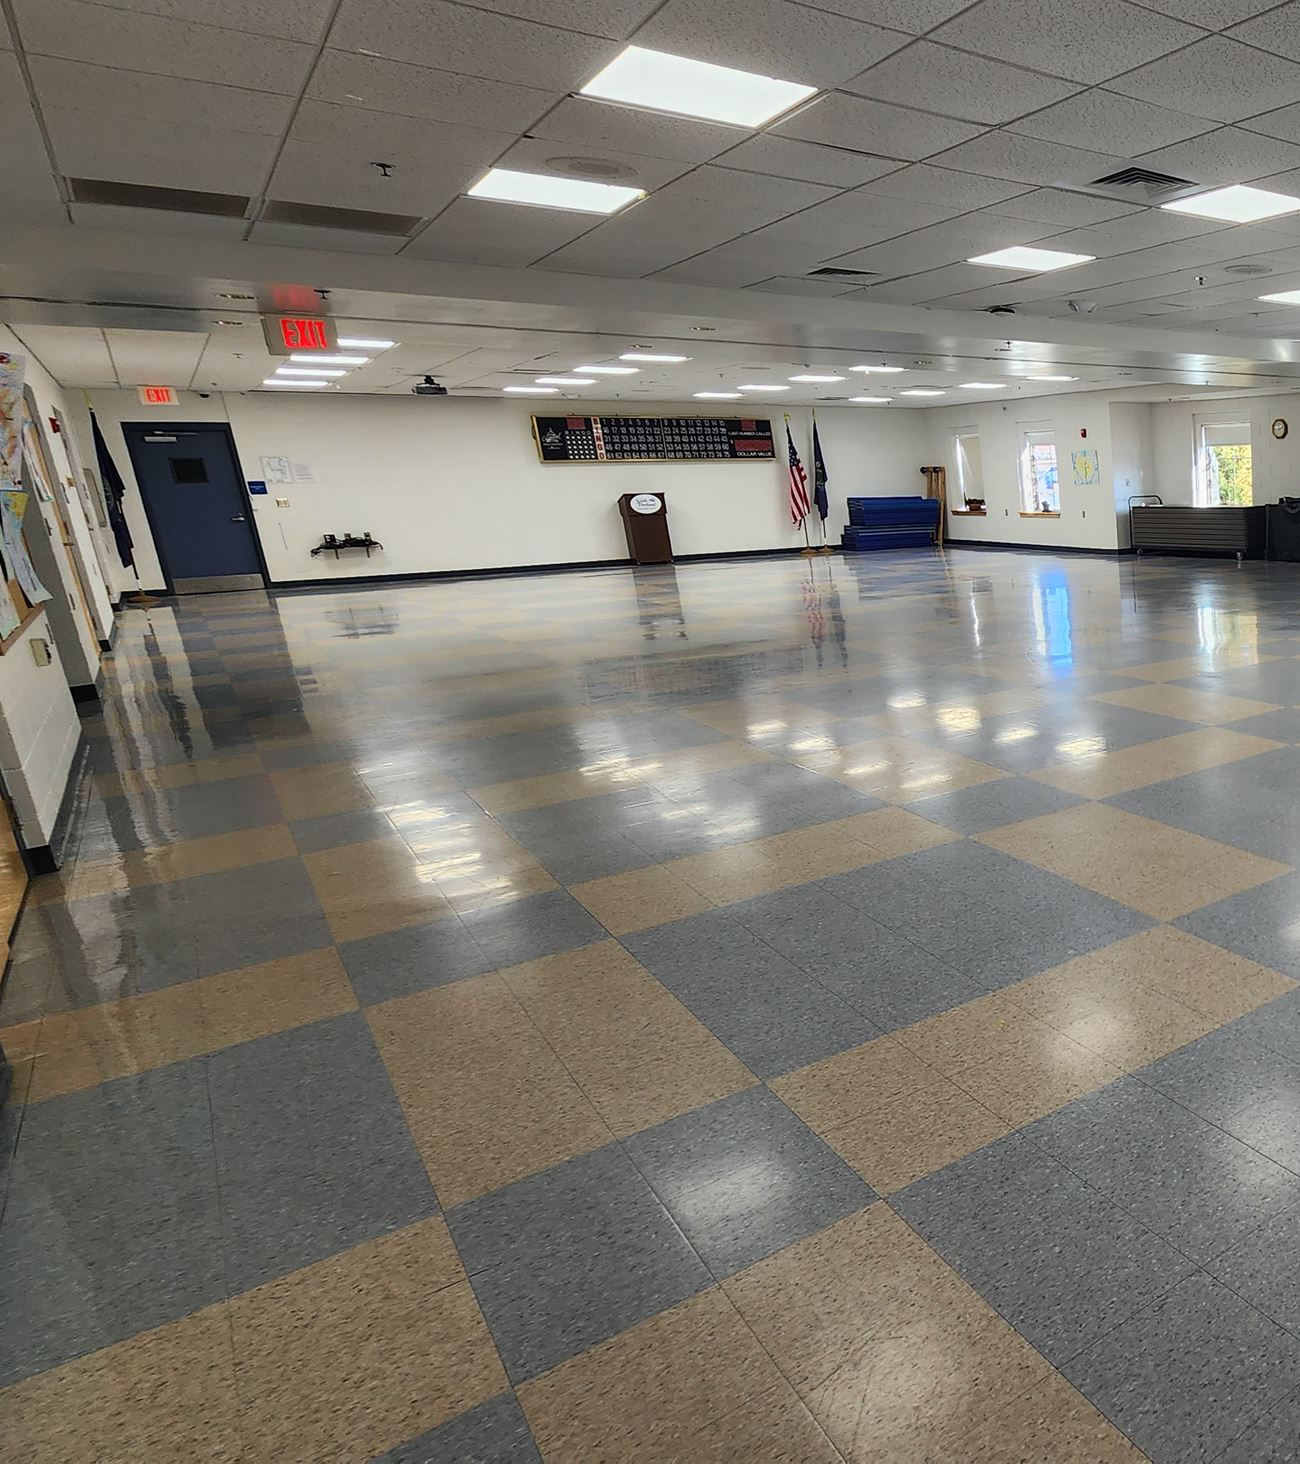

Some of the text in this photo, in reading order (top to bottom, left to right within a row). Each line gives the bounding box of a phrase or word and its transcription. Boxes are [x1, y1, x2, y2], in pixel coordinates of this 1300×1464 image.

[280, 318, 327, 349] EXIT
[144, 387, 171, 402] EXIT
[592, 417, 605, 460] BINGO
